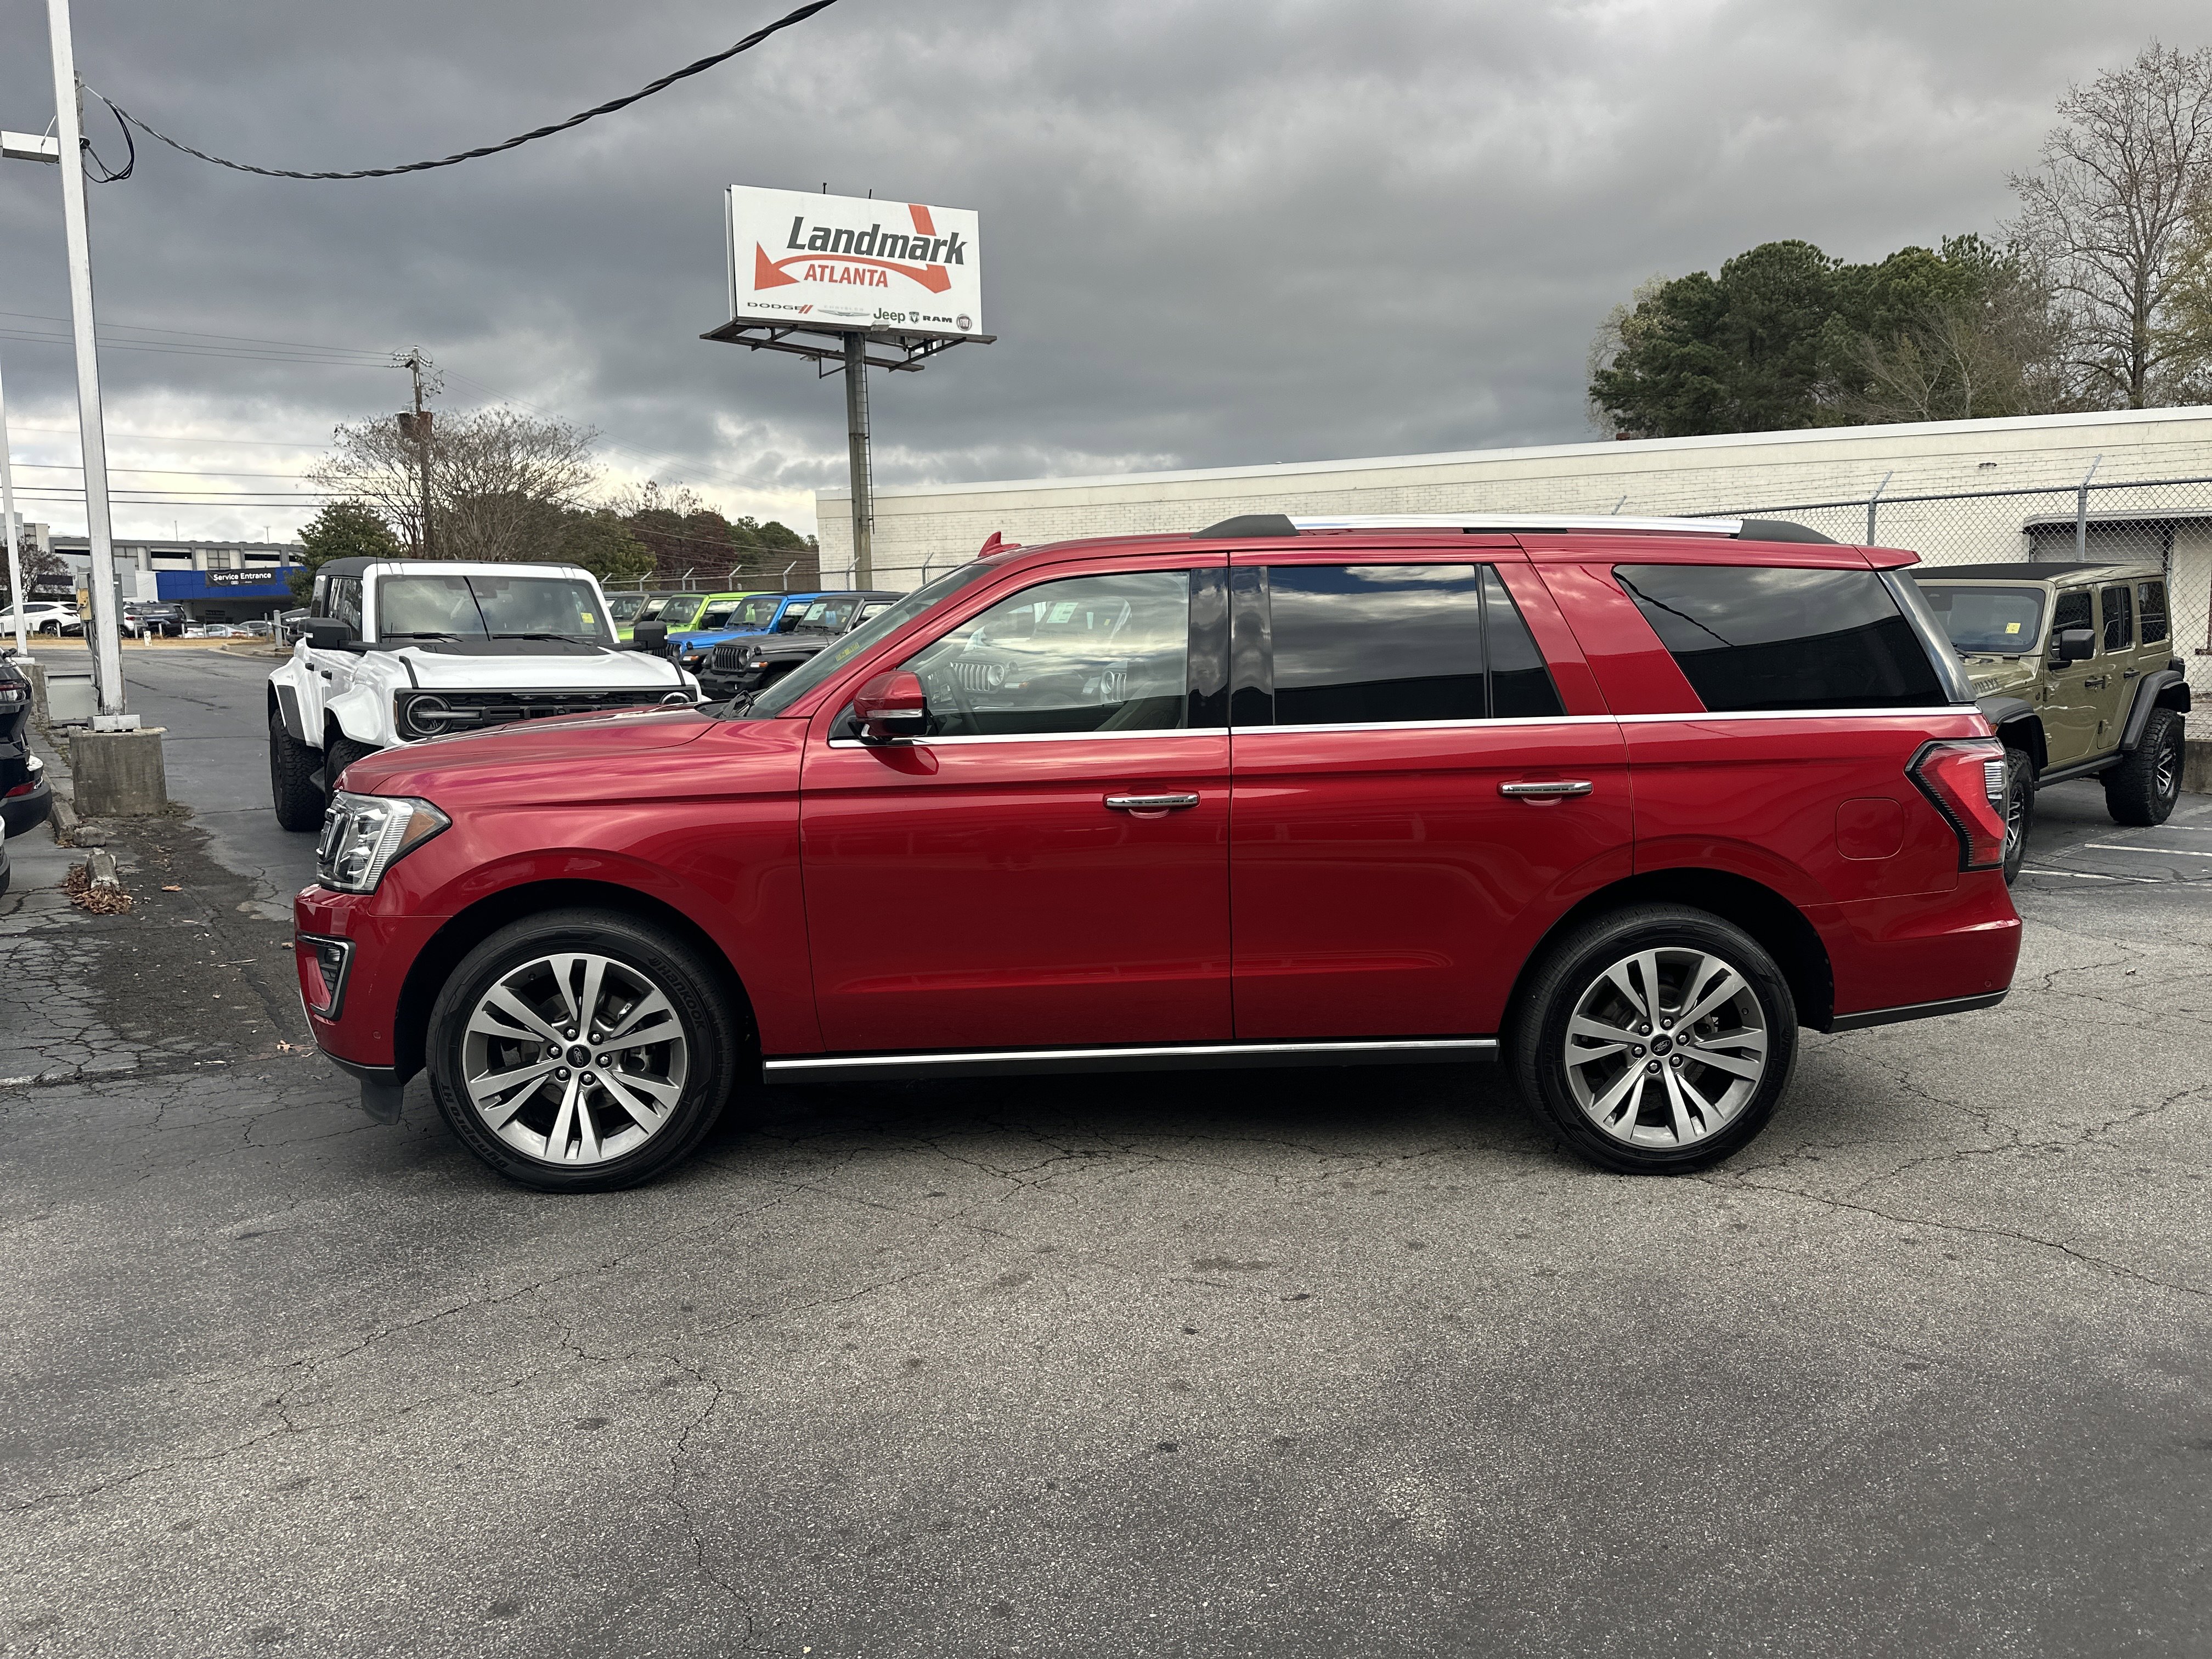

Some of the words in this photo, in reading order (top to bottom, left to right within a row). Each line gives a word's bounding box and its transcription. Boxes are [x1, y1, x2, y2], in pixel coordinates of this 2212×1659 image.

[787, 216, 967, 265] Landmark
[804, 264, 888, 287] ATLANTA
[747, 302, 805, 311] DODGE
[873, 308, 905, 323] Jeep
[657, 964, 706, 1030] Hankook
